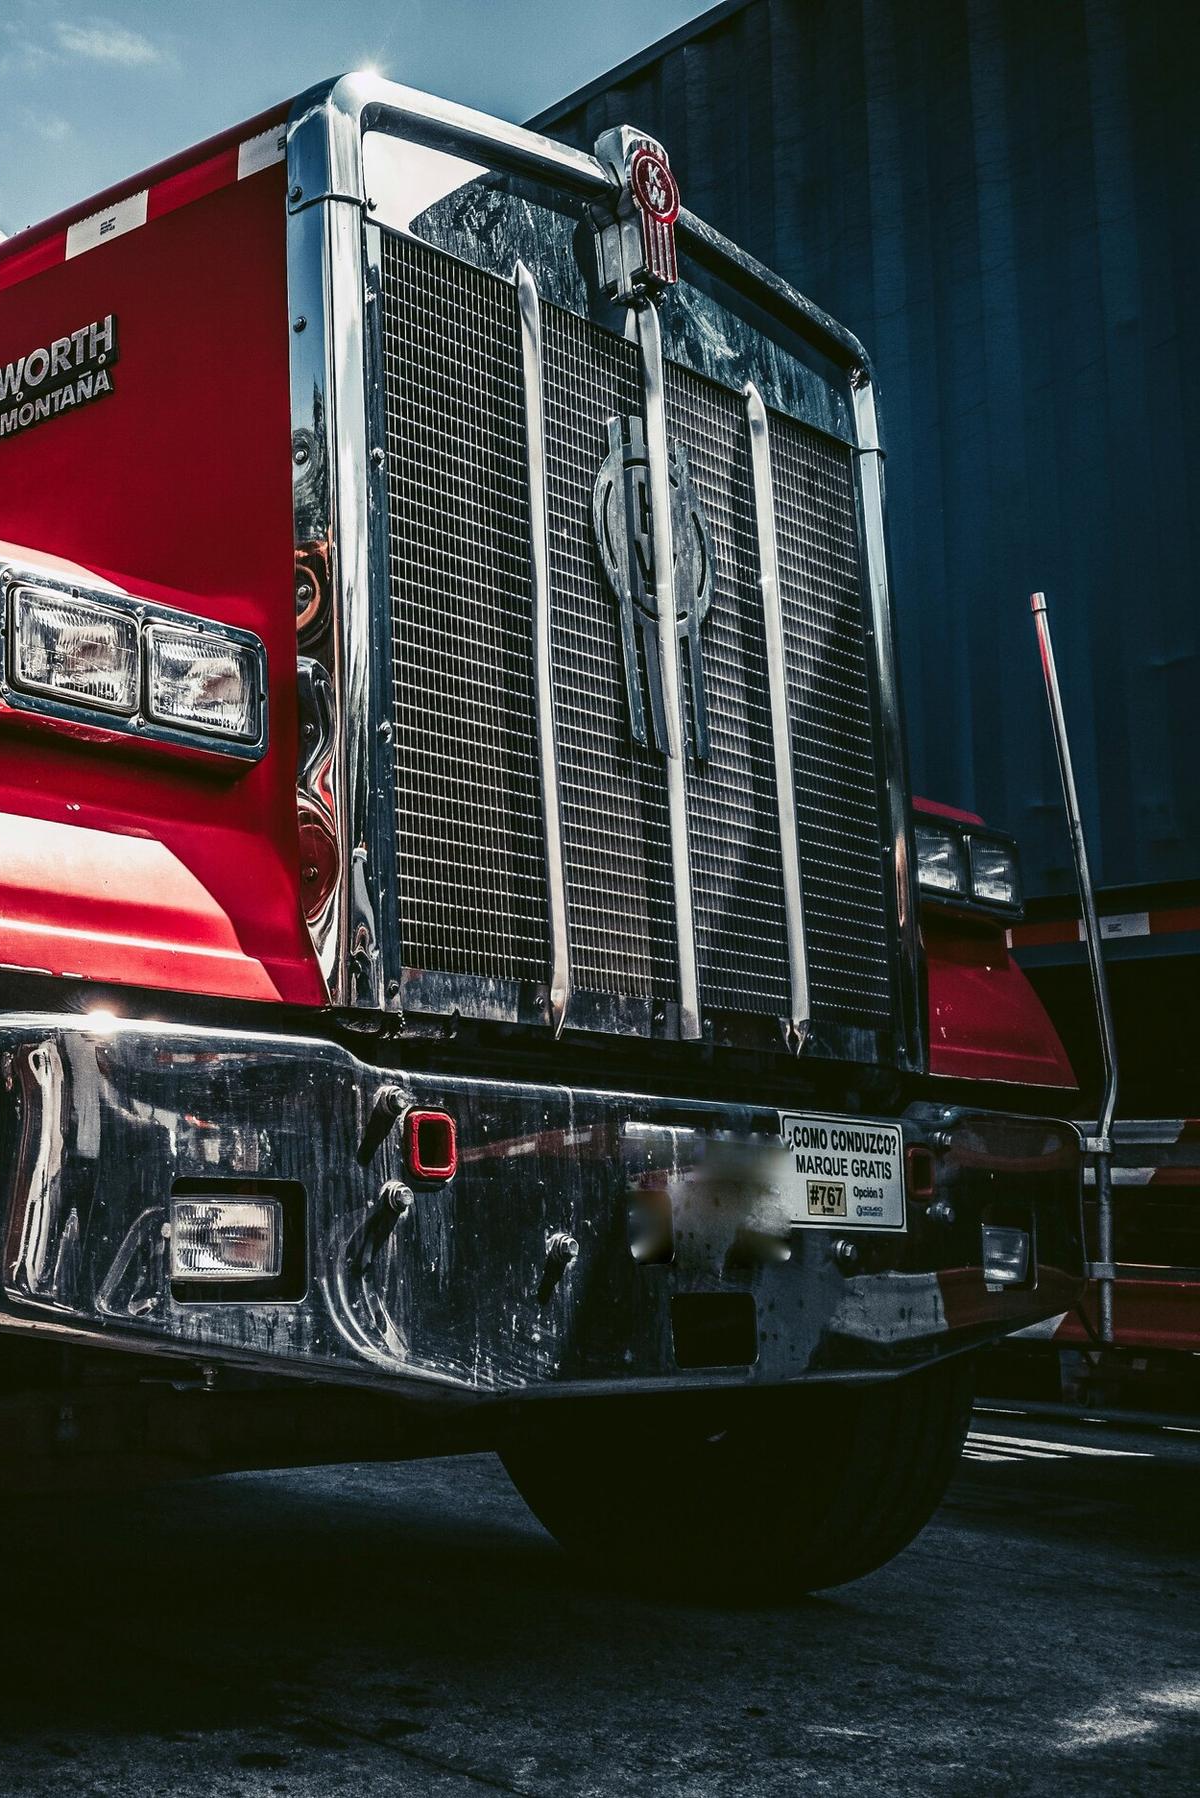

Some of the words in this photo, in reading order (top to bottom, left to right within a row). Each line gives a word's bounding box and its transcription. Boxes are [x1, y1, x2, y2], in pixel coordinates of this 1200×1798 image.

[0, 369, 112, 436] MONTAÑA
[830, 1130, 897, 1156] CONDUZCO?
[796, 1154, 849, 1177] MARQUE
[851, 1159, 893, 1180] GRATIS
[809, 1185, 844, 1207] #767
[853, 1186, 878, 1200] Opción
[879, 1188, 884, 1199] 3
